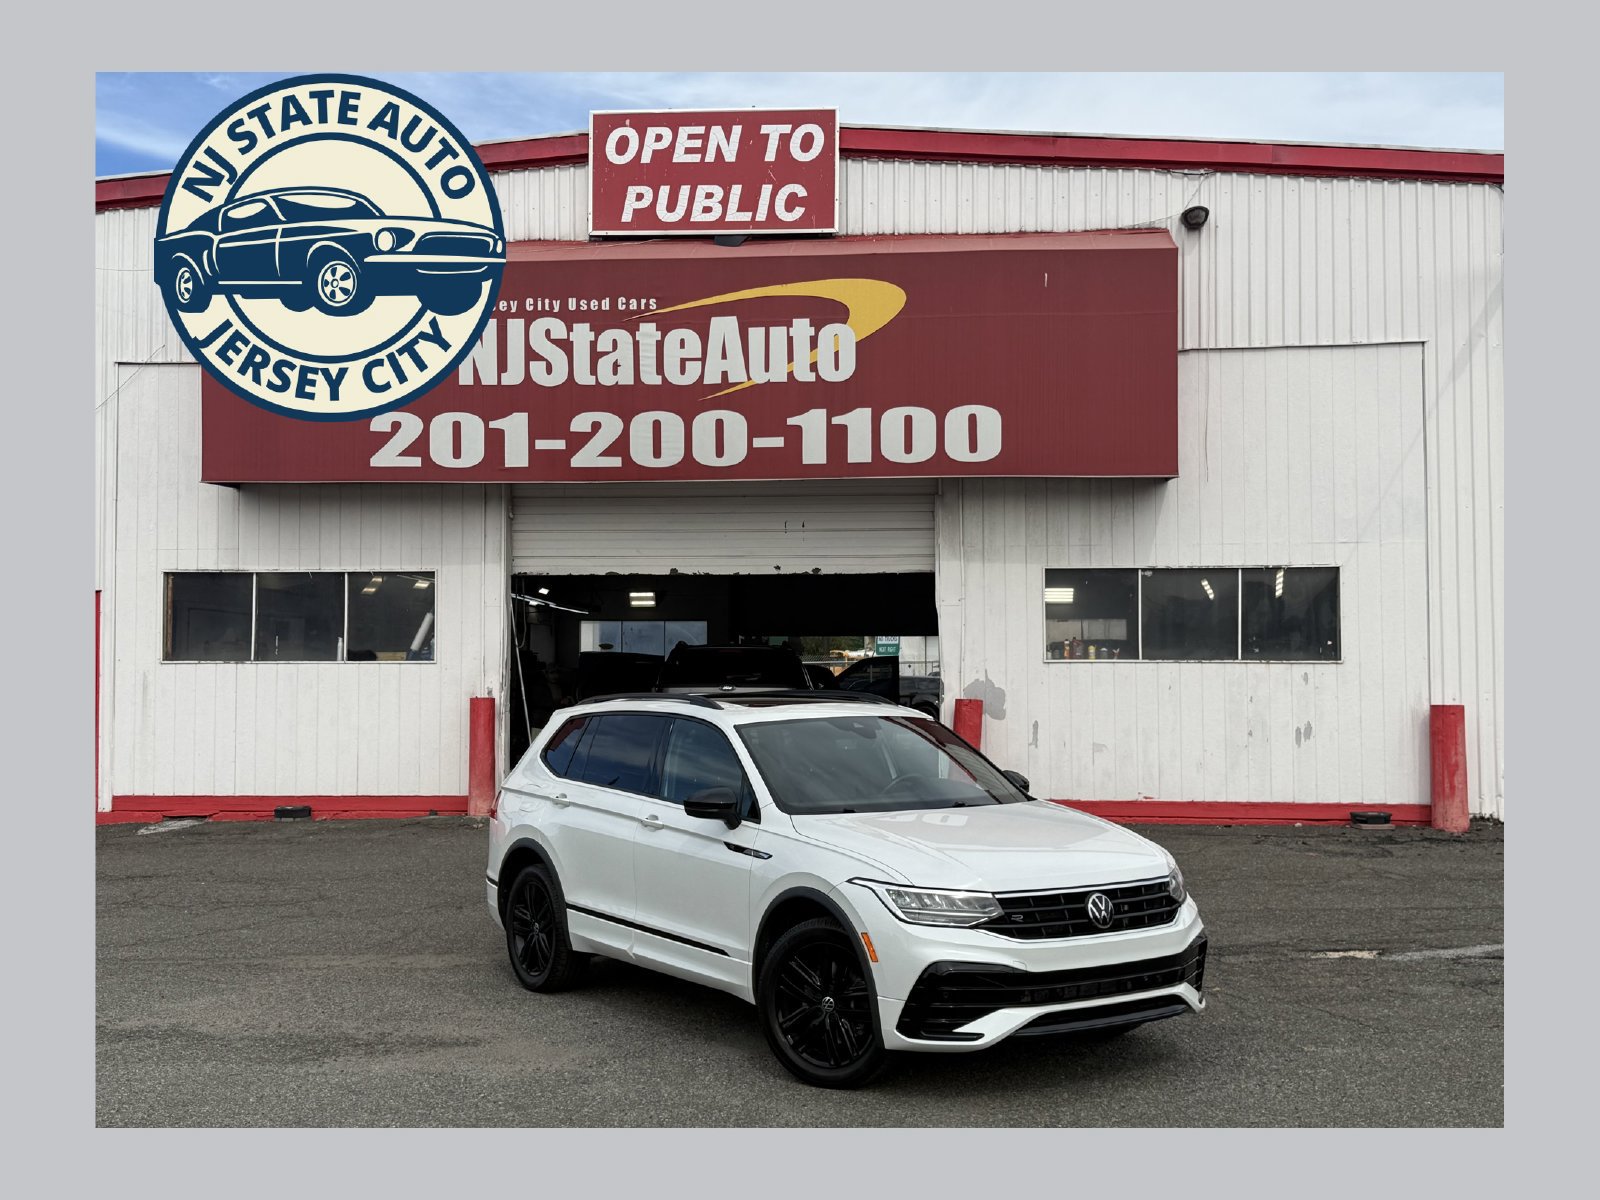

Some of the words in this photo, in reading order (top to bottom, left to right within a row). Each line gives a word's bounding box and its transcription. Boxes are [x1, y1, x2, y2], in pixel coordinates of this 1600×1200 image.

[605, 125, 743, 165] OPEN
[759, 123, 825, 162] TO
[620, 183, 808, 223] PUBLIC
[525, 297, 561, 313] City
[568, 297, 610, 311] Used
[617, 296, 657, 311] Cars
[458, 315, 857, 387] NJStateAuto
[369, 404, 1003, 469] 201-200-1100
